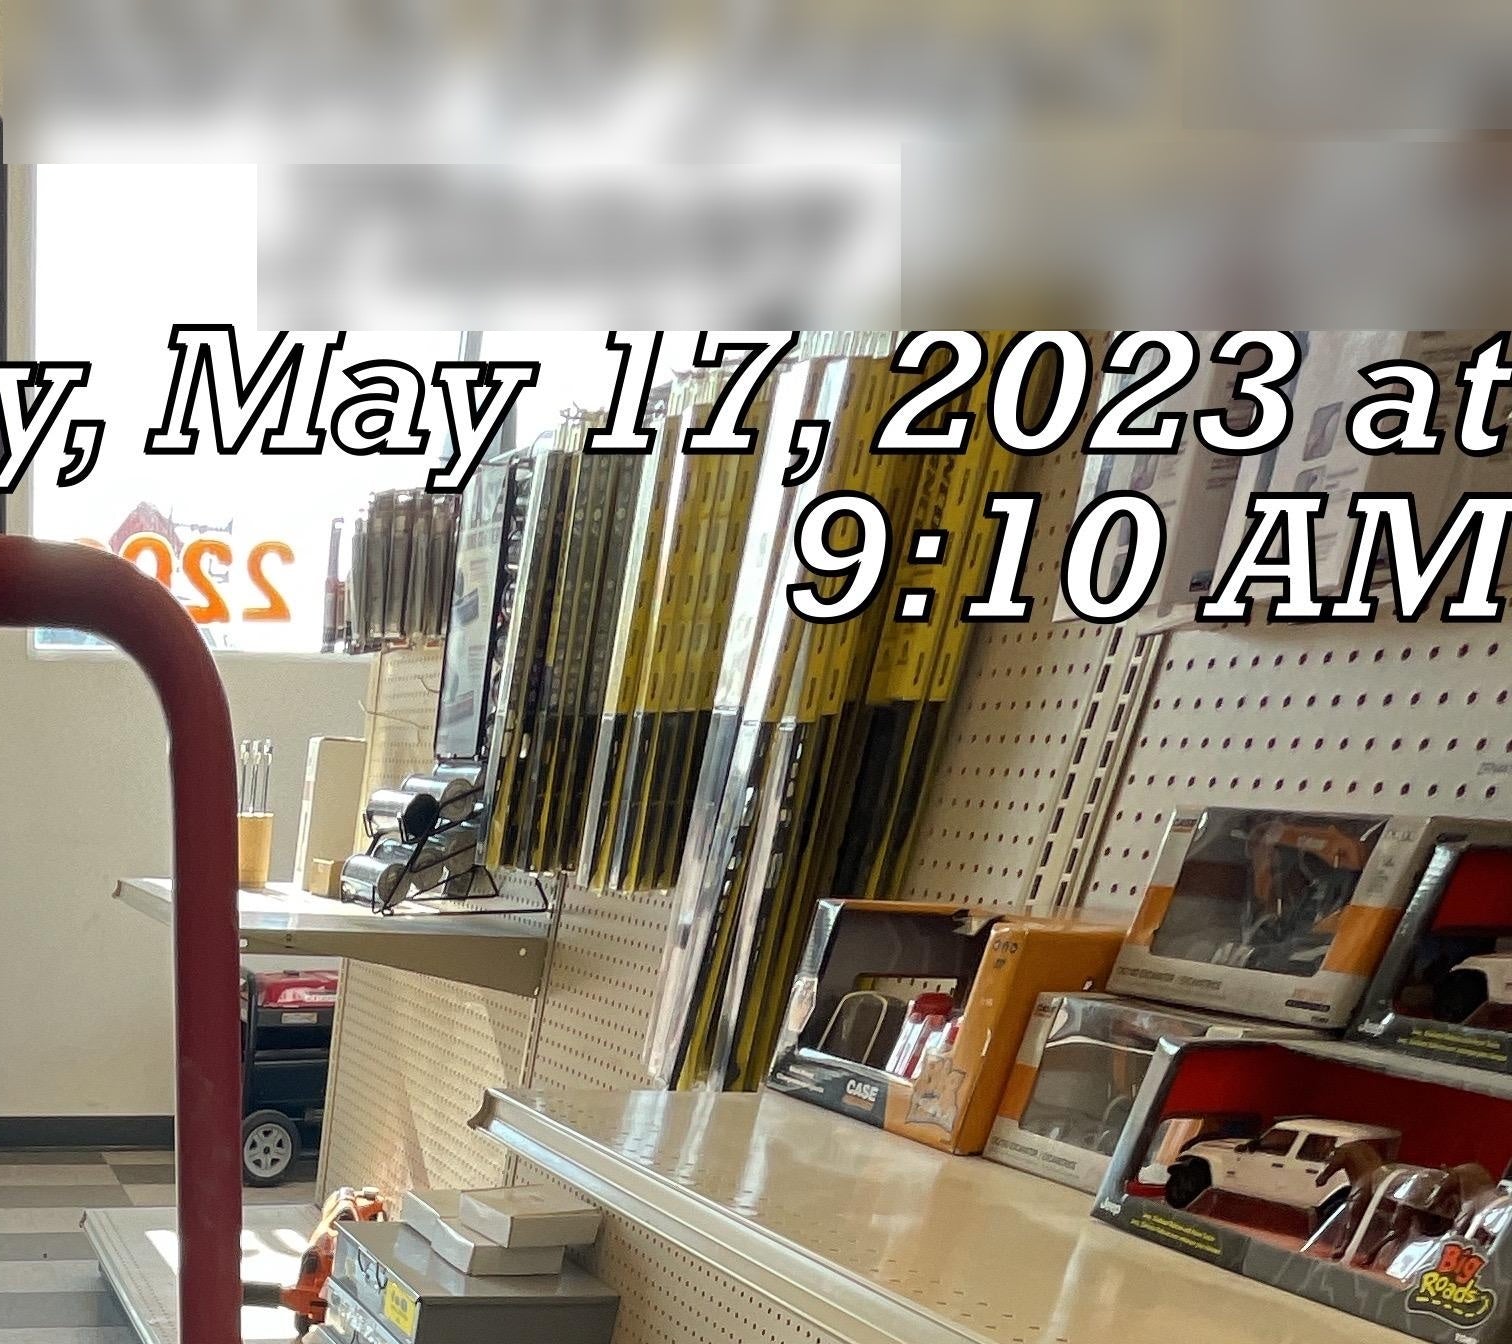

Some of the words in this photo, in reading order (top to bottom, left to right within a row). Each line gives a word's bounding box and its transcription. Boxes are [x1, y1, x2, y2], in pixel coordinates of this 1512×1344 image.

[846, 1079, 880, 1102] CASE
[1438, 1243, 1486, 1285] Big
[1420, 1270, 1479, 1304] Roads
